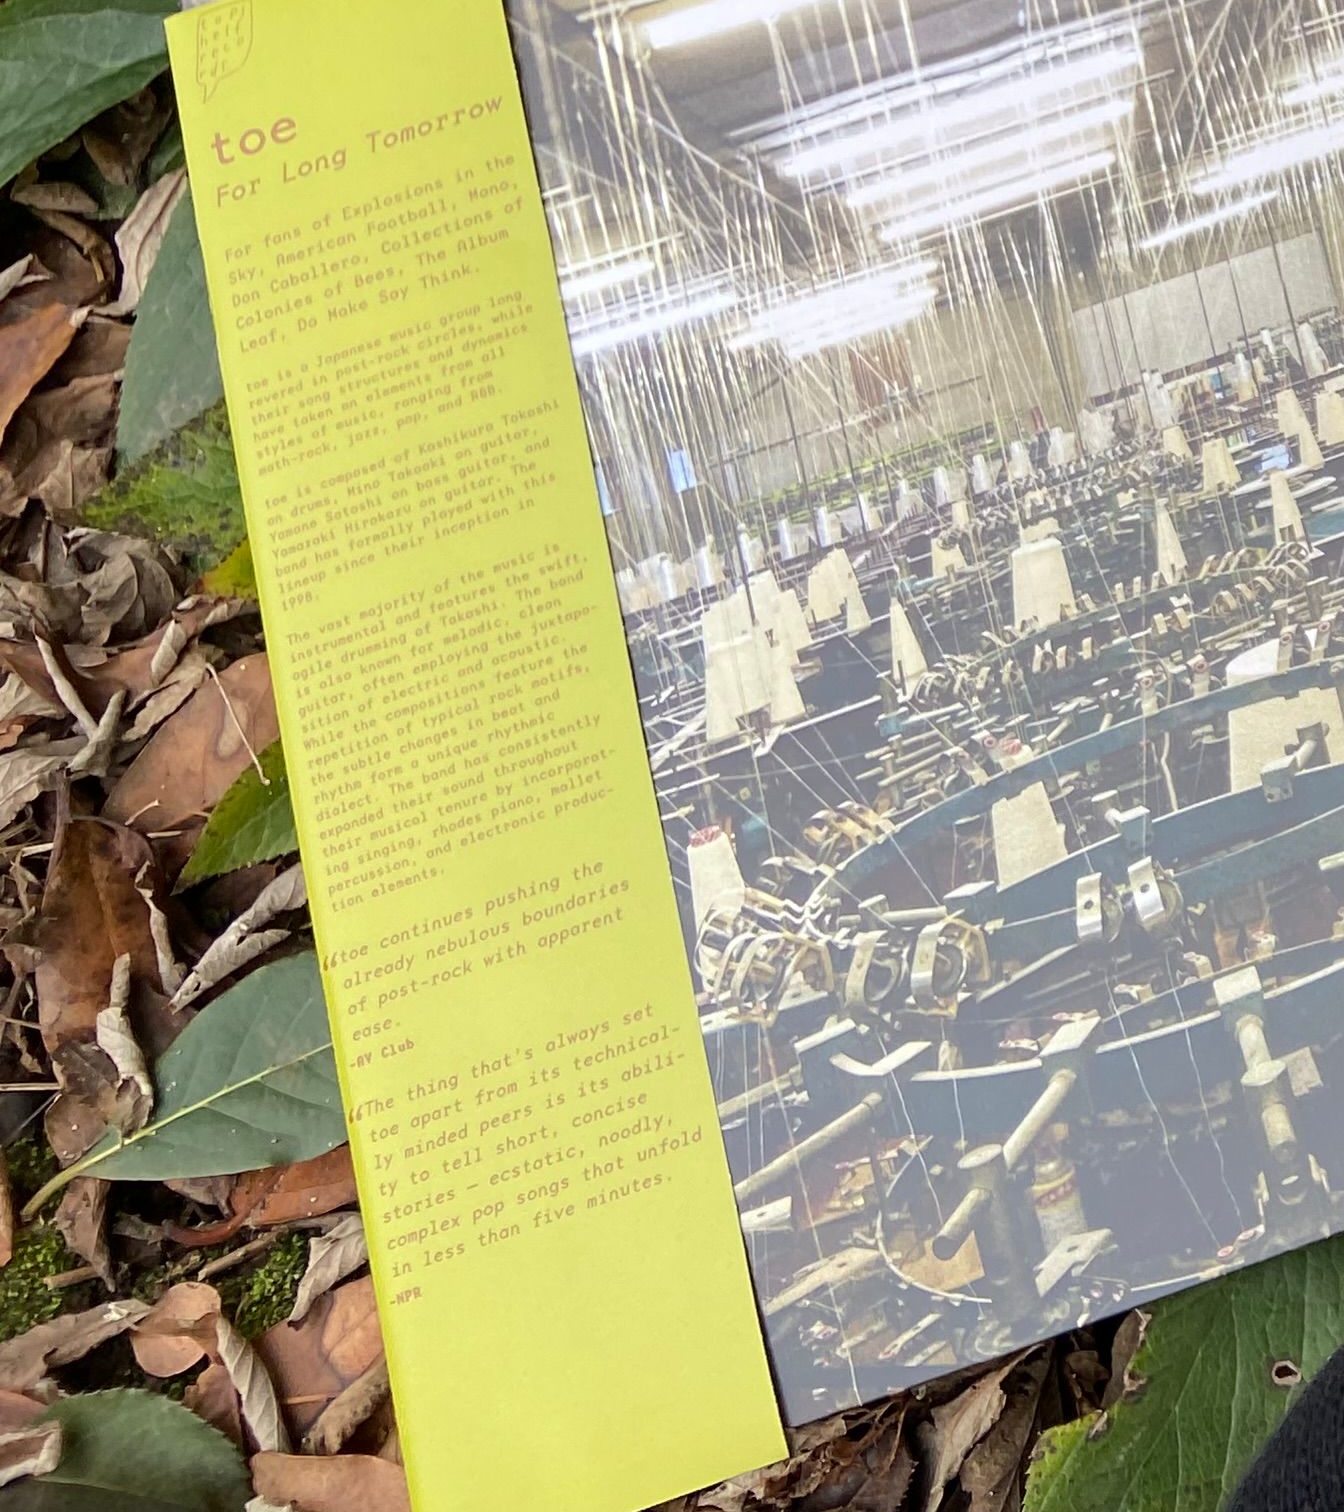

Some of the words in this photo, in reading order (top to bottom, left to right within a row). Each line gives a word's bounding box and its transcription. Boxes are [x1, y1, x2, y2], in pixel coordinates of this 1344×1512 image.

[210, 116, 297, 165] toe
[216, 177, 261, 209] For
[282, 147, 347, 185] Long
[365, 96, 502, 154] Tomorrow
[224, 244, 252, 263] For
[263, 227, 301, 249] fans
[311, 213, 331, 231] of
[342, 179, 444, 221] Explosions
[455, 169, 474, 183] in
[485, 155, 514, 172] the
[231, 290, 261, 308] Don
[381, 210, 493, 255] Collections
[503, 196, 522, 214] of
[276, 232, 357, 268] American
[235, 295, 313, 330] Colonies
[323, 281, 342, 298] of
[415, 250, 447, 267] The
[457, 229, 510, 254] Album
[297, 317, 318, 333] Do
[327, 300, 369, 322] Make
[378, 285, 409, 305] Say
[343, 953, 415, 990] already
[426, 921, 510, 961] nebulous
[522, 879, 630, 927] boundaries
[379, 907, 474, 949] continues
[485, 877, 560, 917] pushing
[572, 861, 604, 881] the
[347, 995, 367, 1016] of
[378, 959, 473, 1009] post-rock
[482, 940, 527, 969] with
[537, 906, 624, 949] apparent
[380, 1037, 415, 1059] Club
[407, 1074, 459, 1102] thing
[545, 1020, 610, 1053] always
[622, 1001, 653, 1026] set
[369, 1123, 400, 1143] toe
[410, 1098, 463, 1130] apart
[474, 1081, 518, 1106] from
[529, 1066, 561, 1087] its
[374, 1153, 393, 1171] ly
[404, 1122, 468, 1160] minded
[479, 1104, 533, 1137] peers
[545, 1093, 566, 1110] is
[577, 1077, 609, 1098] its
[378, 1179, 399, 1198] ty
[409, 1169, 431, 1185] to
[442, 1146, 483, 1174] tell
[571, 1092, 648, 1129] concise
[382, 1188, 456, 1224] stories
[387, 1215, 461, 1251] complex
[472, 1200, 505, 1225] pop
[516, 1177, 570, 1205] songs
[581, 1155, 625, 1182] that
[636, 1124, 702, 1162] unfold
[392, 1261, 413, 1278] in
[423, 1242, 465, 1267] less
[477, 1223, 521, 1247] than
[532, 1204, 576, 1229] five
